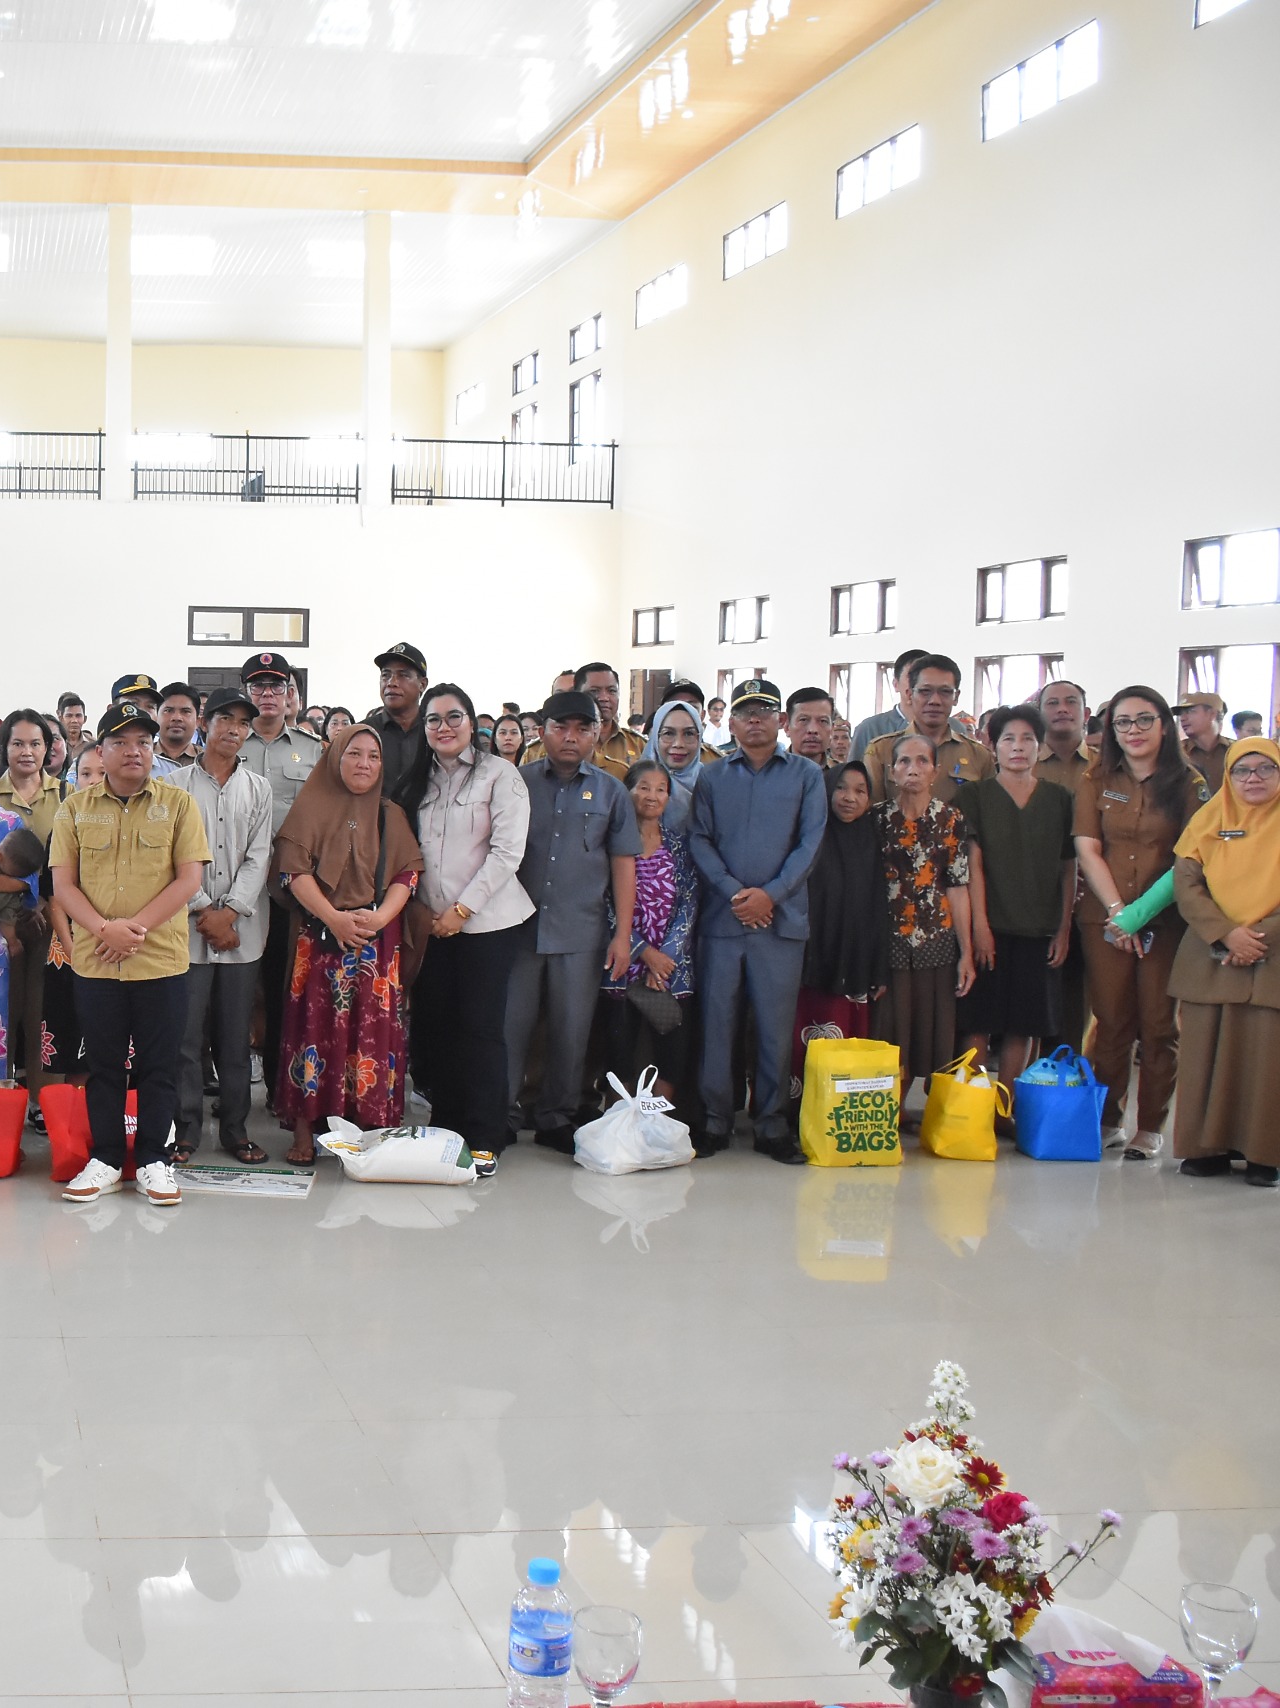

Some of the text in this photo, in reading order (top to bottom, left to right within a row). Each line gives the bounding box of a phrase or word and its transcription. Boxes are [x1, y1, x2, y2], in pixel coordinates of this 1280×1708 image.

[849, 1091, 885, 1109] ECO
[849, 1123, 868, 1131] WITH
[834, 1130, 897, 1153] BAGS
